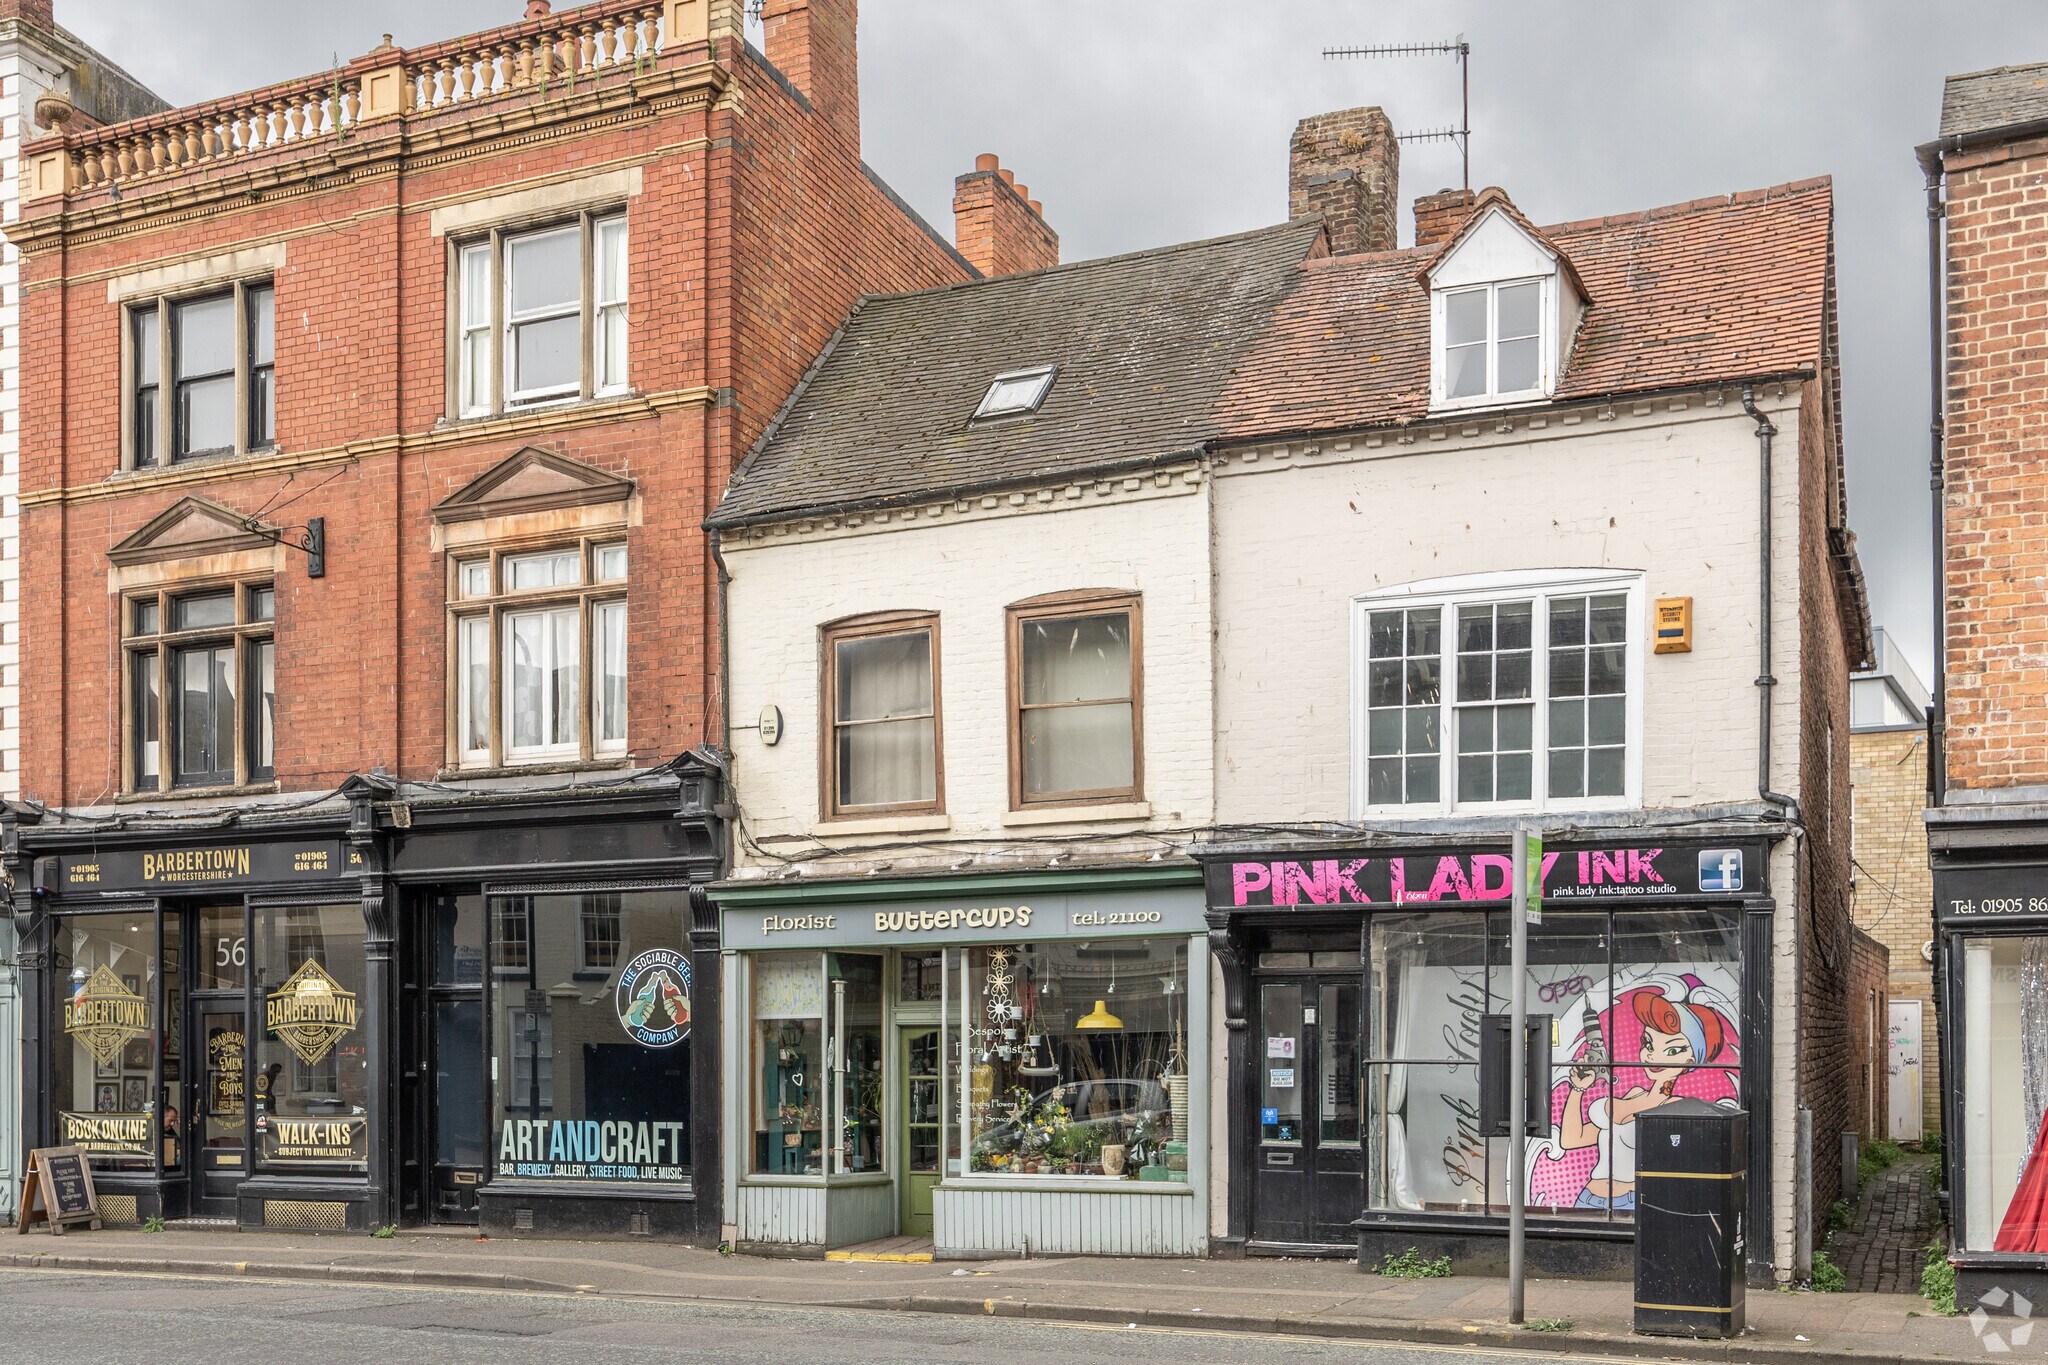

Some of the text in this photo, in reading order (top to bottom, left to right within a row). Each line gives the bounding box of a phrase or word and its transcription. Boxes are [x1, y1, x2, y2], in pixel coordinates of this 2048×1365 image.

[144, 848, 250, 880] BARBERTOWN
[302, 851, 328, 861] 01905
[76, 864, 100, 873] 01905
[294, 861, 328, 871] 616 464
[70, 873, 100, 883] 616 464
[167, 871, 227, 882] WORCESTERSHIRE
[1232, 858, 1372, 906] PINK
[1578, 848, 1664, 885] INK
[1553, 884, 1677, 898] pink lady ink:tattoo studio
[1951, 897, 2048, 914] Tel: 01905 86
[1072, 910, 1161, 926] tel: 21100
[216, 937, 246, 967] 56
[621, 952, 691, 988] THE SOCIABLE BEE
[1538, 975, 1594, 1004] open
[65, 999, 145, 1029] BARBERTOWN
[267, 995, 356, 1027] BARBERTOWN
[637, 1027, 680, 1044] COMPANY
[968, 1023, 1006, 1041] Bespo
[955, 1041, 987, 1056] Foral
[219, 1056, 243, 1072] MEN
[219, 1081, 244, 1096] BOYS
[67, 1119, 147, 1140] BOOK ONLINE
[277, 1122, 351, 1145] WALK-INS
[278, 1147, 352, 1157] SUBJECT TO AVAILABILITY
[499, 1162, 683, 1180] BAR, BREWERY, GALLERY, STREET FOOD, LIVE MUSIC
